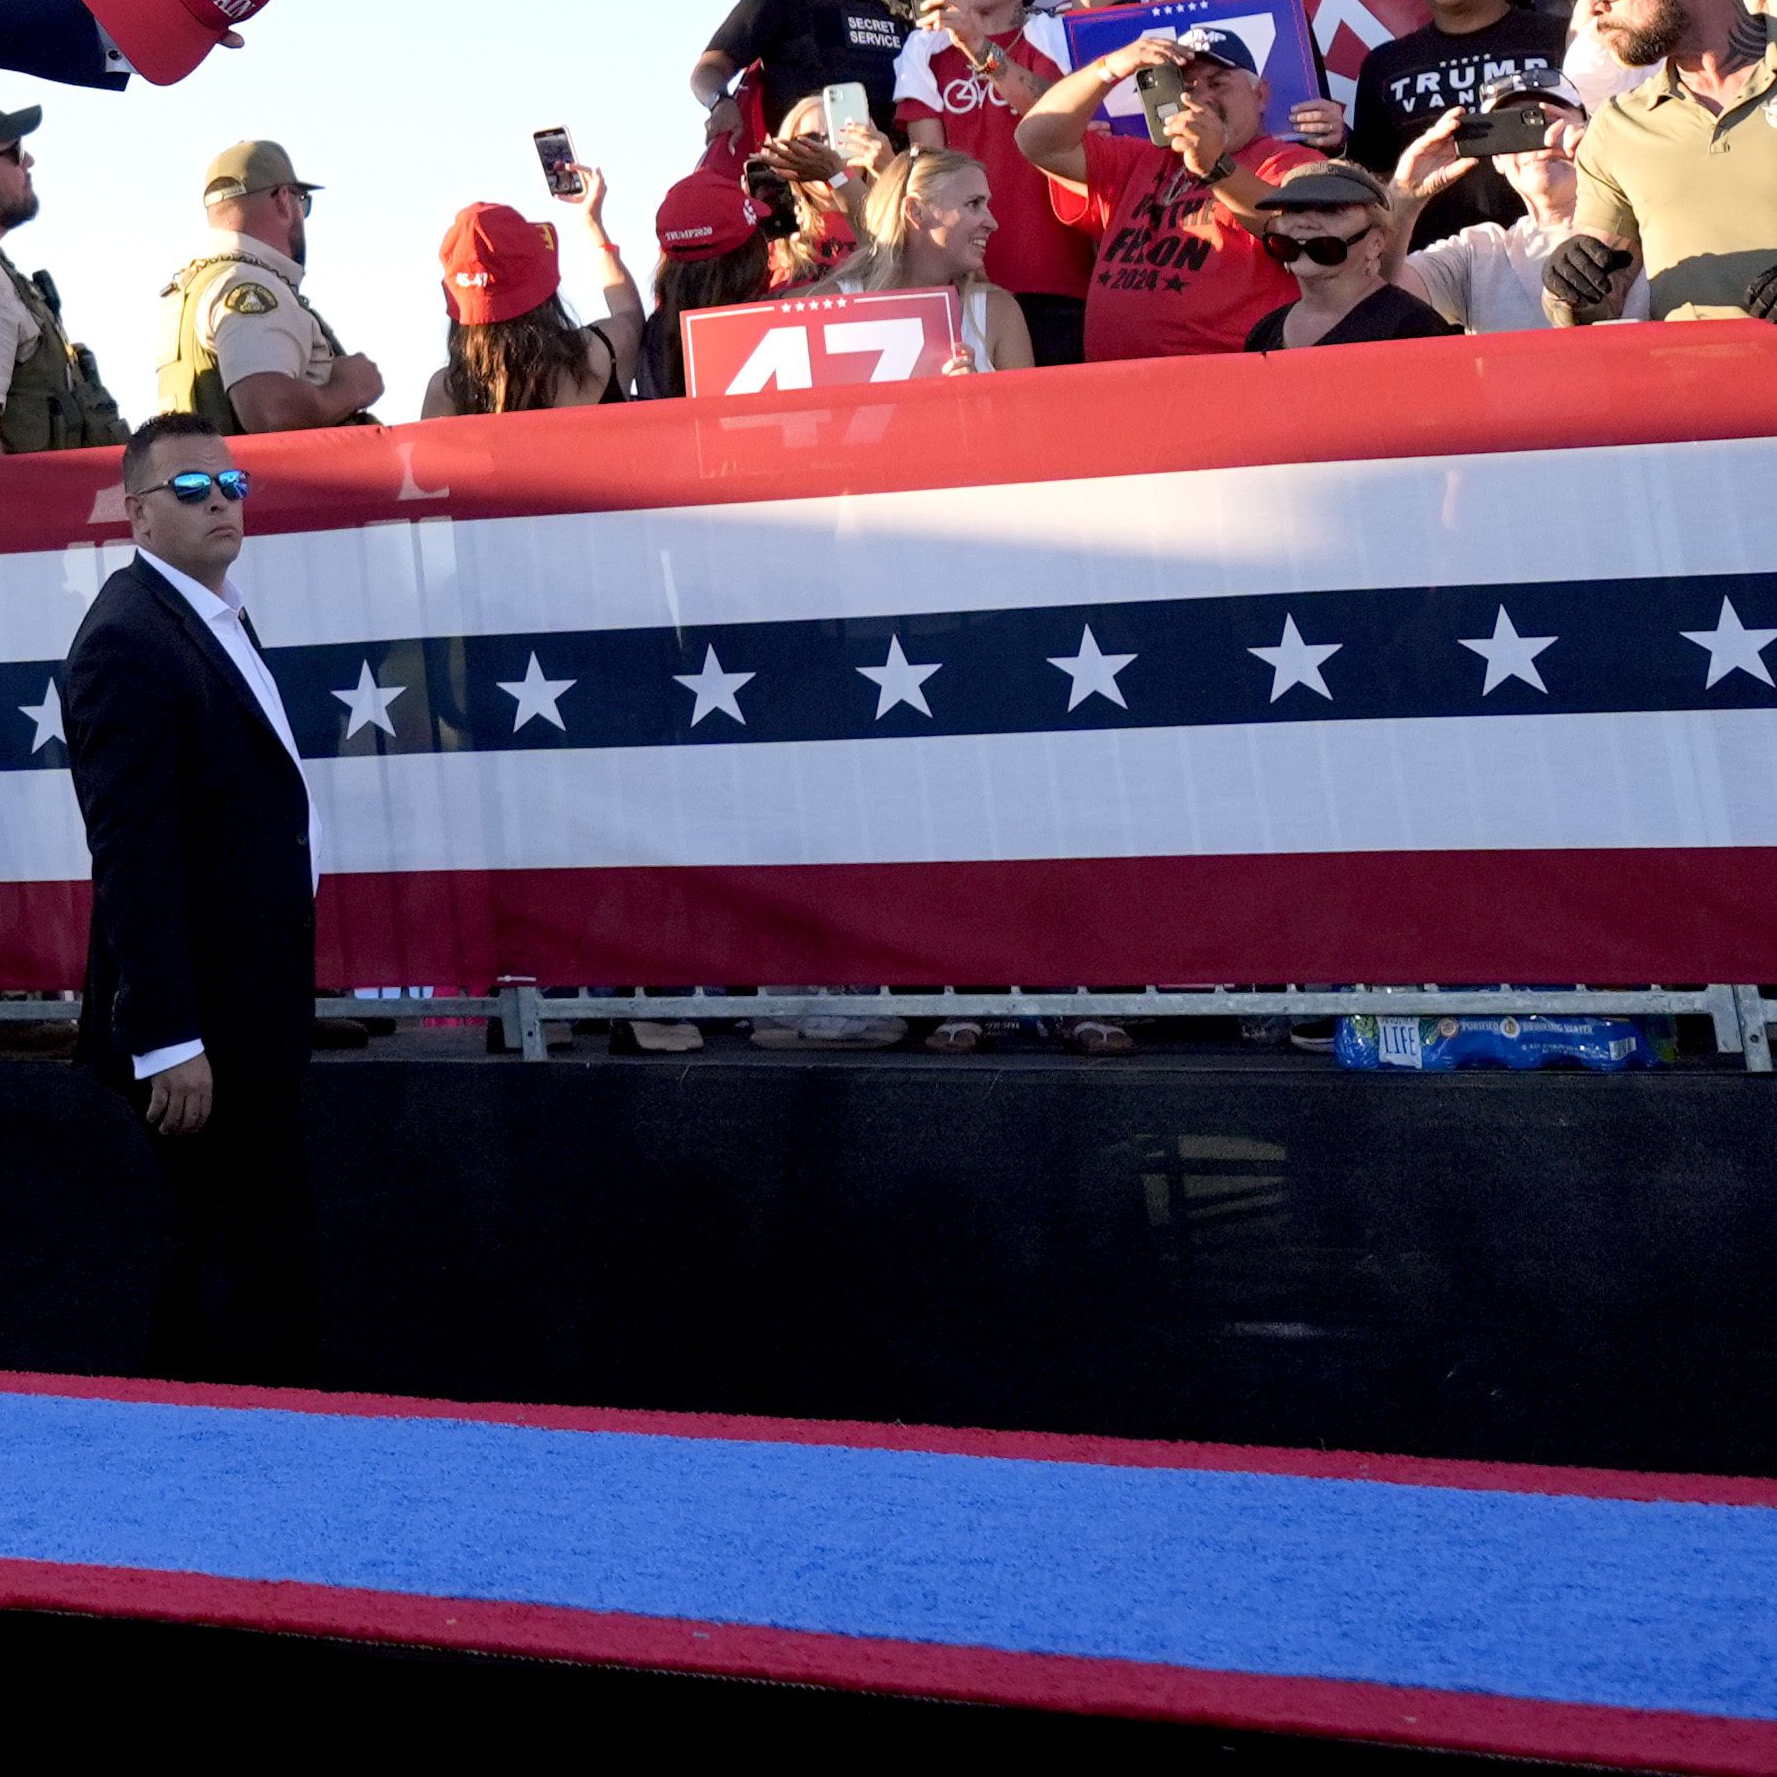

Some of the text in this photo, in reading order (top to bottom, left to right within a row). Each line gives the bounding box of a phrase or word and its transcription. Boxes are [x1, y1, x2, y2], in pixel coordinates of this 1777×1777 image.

[847, 15, 896, 35] SECRET
[849, 31, 902, 50] SERVICE
[1402, 88, 1475, 113] VAN
[664, 225, 714, 242] TRUMP2020
[1104, 228, 1212, 272] FELON
[455, 272, 489, 289] 45-47
[724, 317, 925, 396] 47
[1383, 1025, 1418, 1056] LIFE
